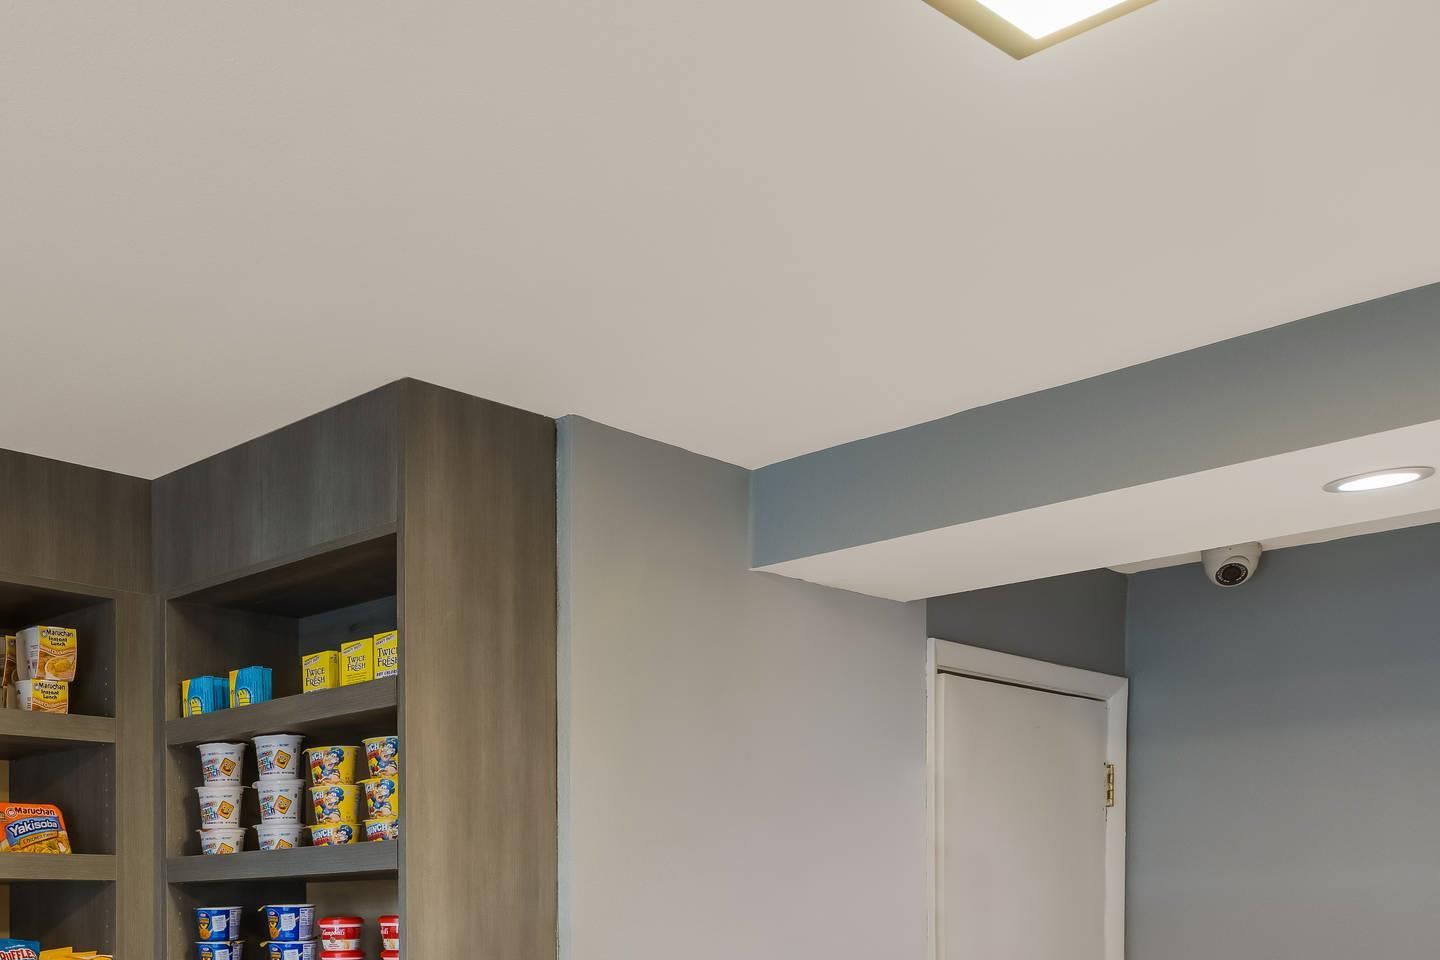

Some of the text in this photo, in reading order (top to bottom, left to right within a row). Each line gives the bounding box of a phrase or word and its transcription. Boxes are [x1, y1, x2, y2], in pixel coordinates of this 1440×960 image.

[47, 629, 73, 638] Maruchan
[377, 648, 397, 658] TWIC
[347, 655, 366, 664] TWICE
[306, 667, 325, 676] TWICE
[347, 663, 366, 672] FRESH
[39, 682, 66, 690] Maruchan
[306, 676, 326, 687] FRESH
[15, 807, 55, 816] Maruchan
[9, 820, 58, 837] Yakisoba
